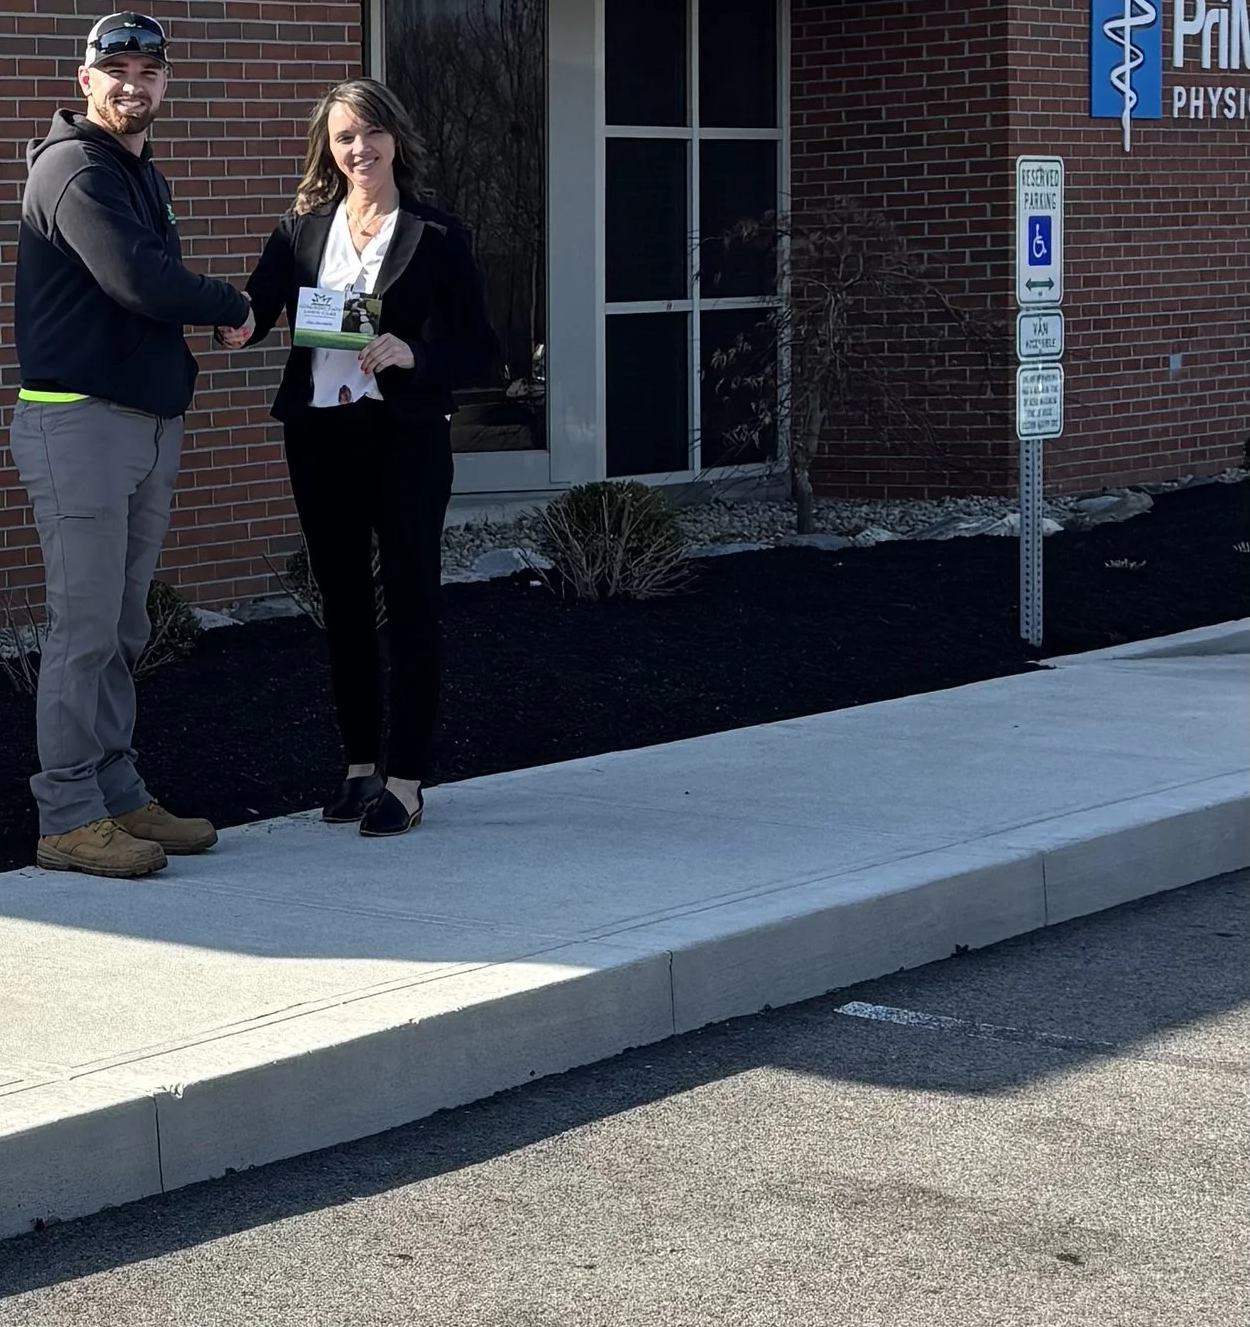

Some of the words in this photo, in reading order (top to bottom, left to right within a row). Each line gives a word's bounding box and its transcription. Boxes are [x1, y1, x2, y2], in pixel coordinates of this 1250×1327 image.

[1173, 85, 1250, 120] PHYSI
[1022, 169, 1059, 187] RESERVED
[1023, 192, 1057, 210] PARKING
[1032, 321, 1049, 336] VAN
